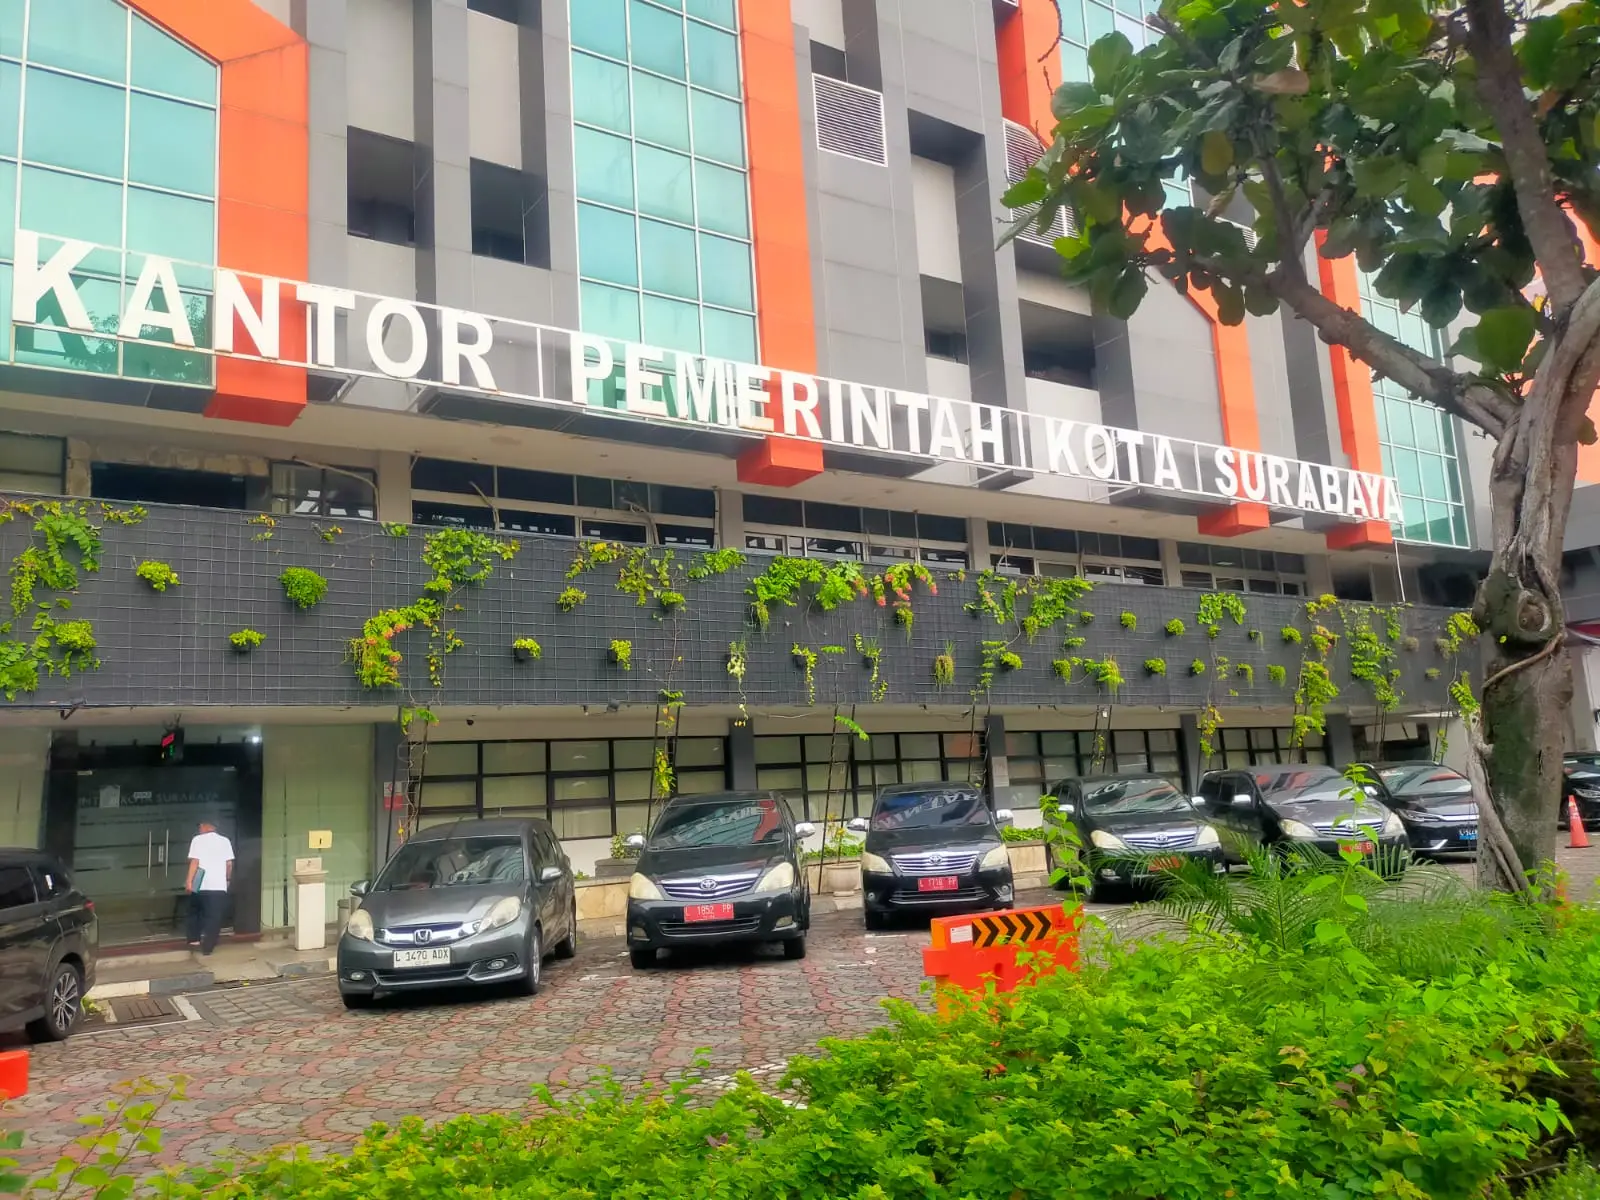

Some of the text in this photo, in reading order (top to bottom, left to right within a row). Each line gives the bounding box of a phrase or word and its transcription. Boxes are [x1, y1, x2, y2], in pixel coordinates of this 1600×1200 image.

[12, 229, 1405, 522] KANTOR PEMERINTAH KOTA SURABAYA
[395, 952, 401, 961] L
[404, 950, 428, 961] 1470
